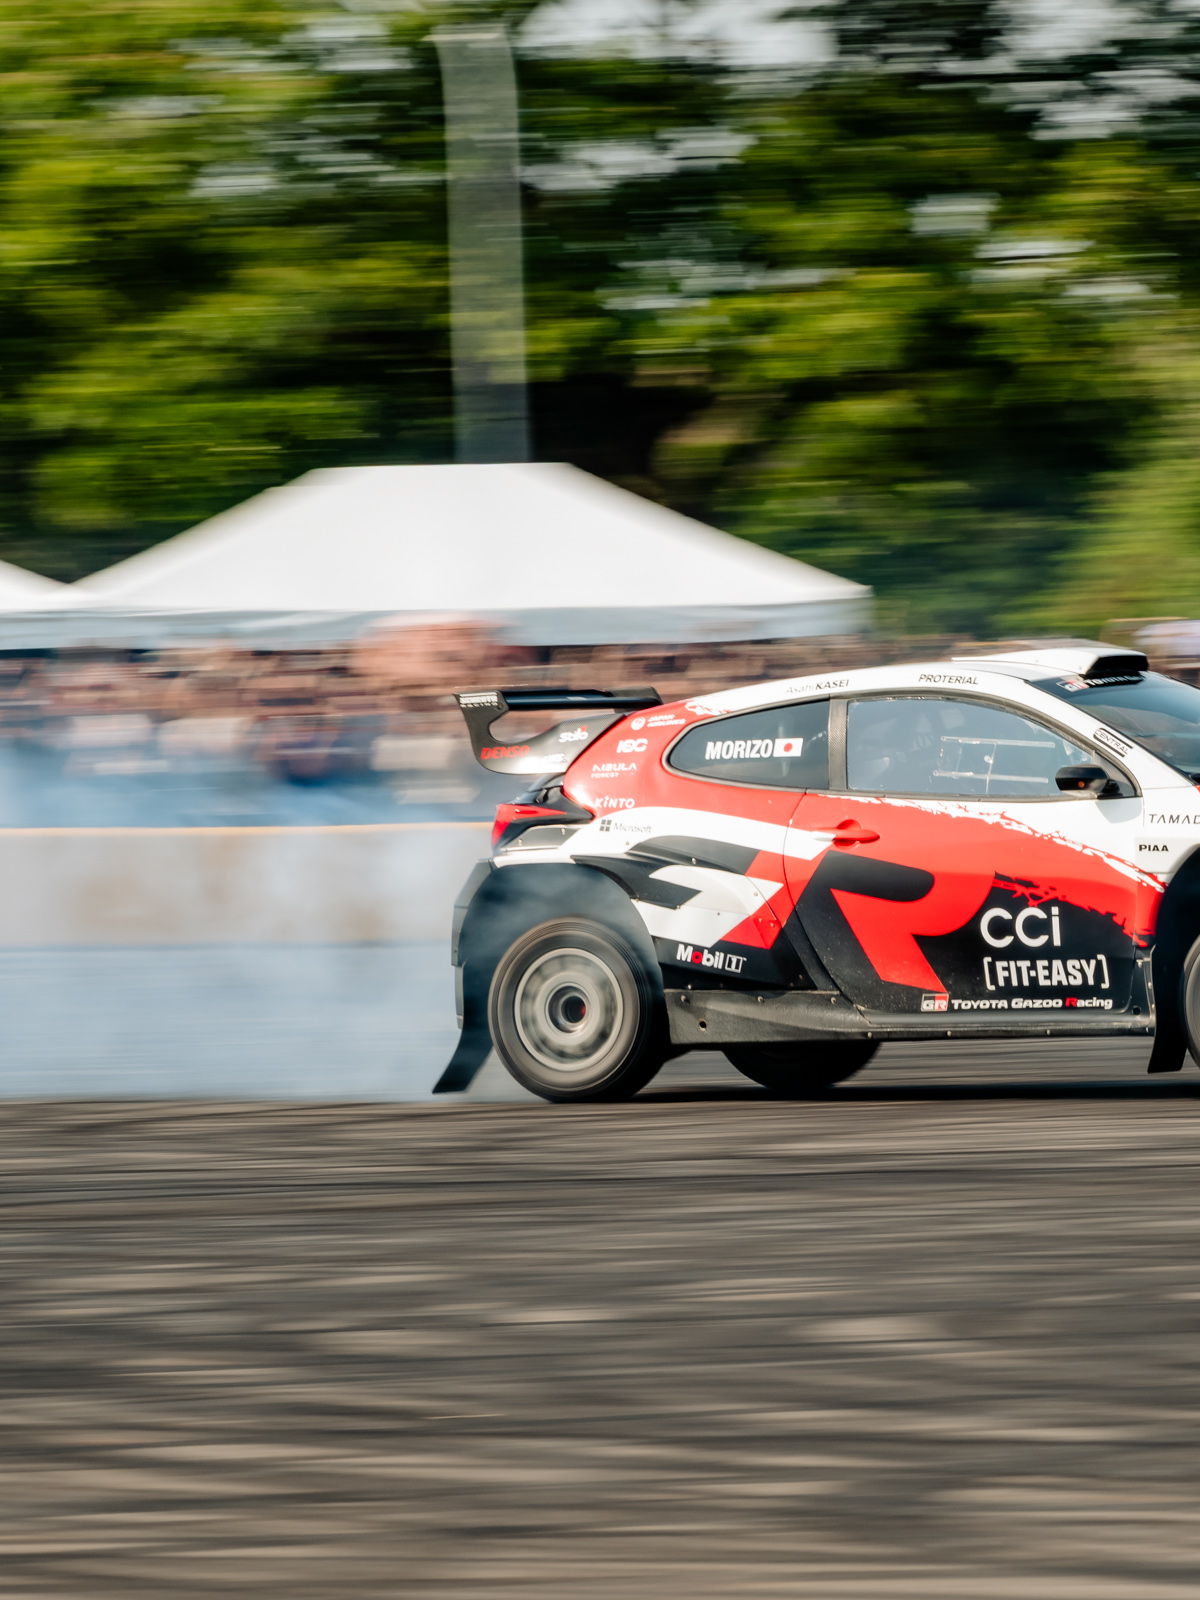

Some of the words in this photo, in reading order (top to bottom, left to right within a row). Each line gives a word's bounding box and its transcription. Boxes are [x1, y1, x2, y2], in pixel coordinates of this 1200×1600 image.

[918, 674, 979, 685] PROTERIAL
[705, 739, 773, 760] MORIZO
[1094, 729, 1128, 755] CENTRAL
[481, 745, 530, 760] DENSO
[1138, 844, 1169, 852] PIAA
[676, 943, 725, 969] Mobil
[951, 999, 1008, 1010] TOYOTA
[1011, 998, 1063, 1009] GAZOO
[1065, 997, 1113, 1010] Racing
